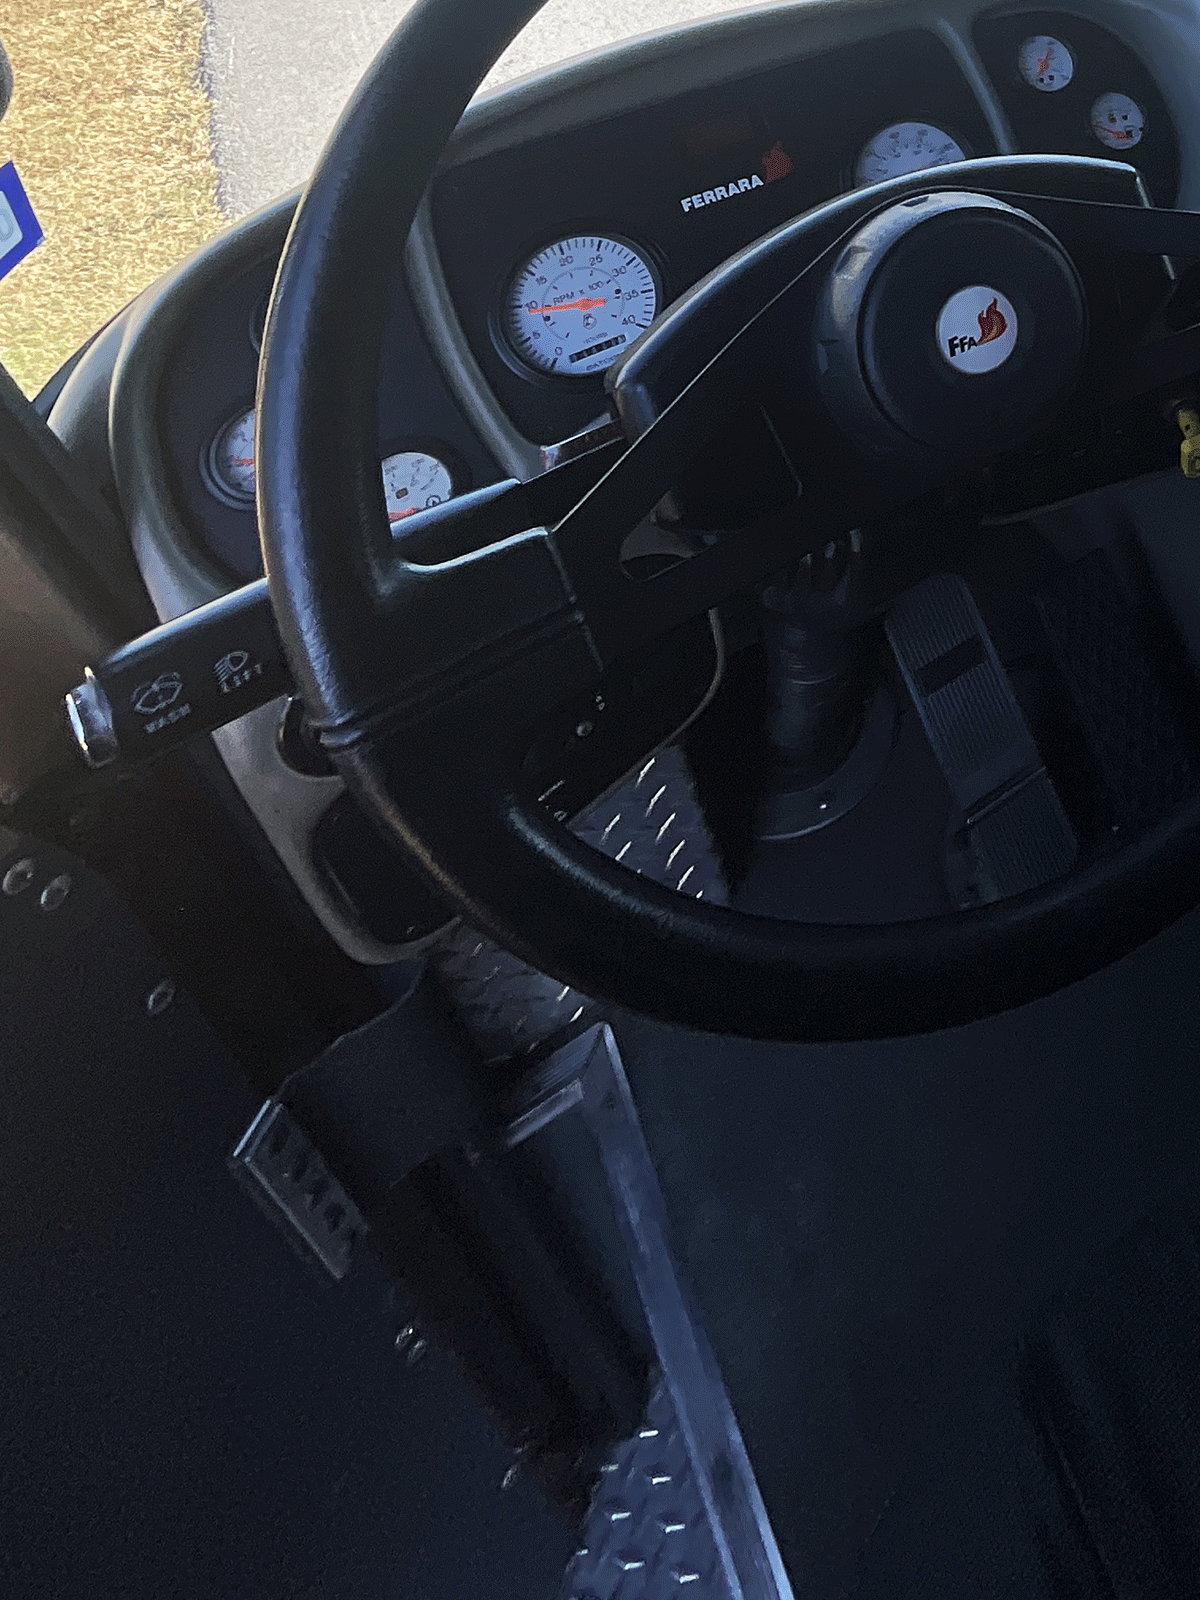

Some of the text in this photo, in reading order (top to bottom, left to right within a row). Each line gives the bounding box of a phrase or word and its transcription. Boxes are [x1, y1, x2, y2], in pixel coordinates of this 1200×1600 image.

[680, 174, 764, 213] FERRARA
[559, 255, 574, 267] 20
[589, 254, 603, 266] 25
[611, 265, 627, 278] 30
[535, 276, 548, 286] 15
[553, 291, 575, 304] RPM
[588, 280, 605, 291] 100
[623, 289, 639, 300] 35
[525, 300, 539, 310] 10
[621, 314, 636, 326] 40
[554, 346, 563, 356] 0
[948, 336, 978, 358] FFA
